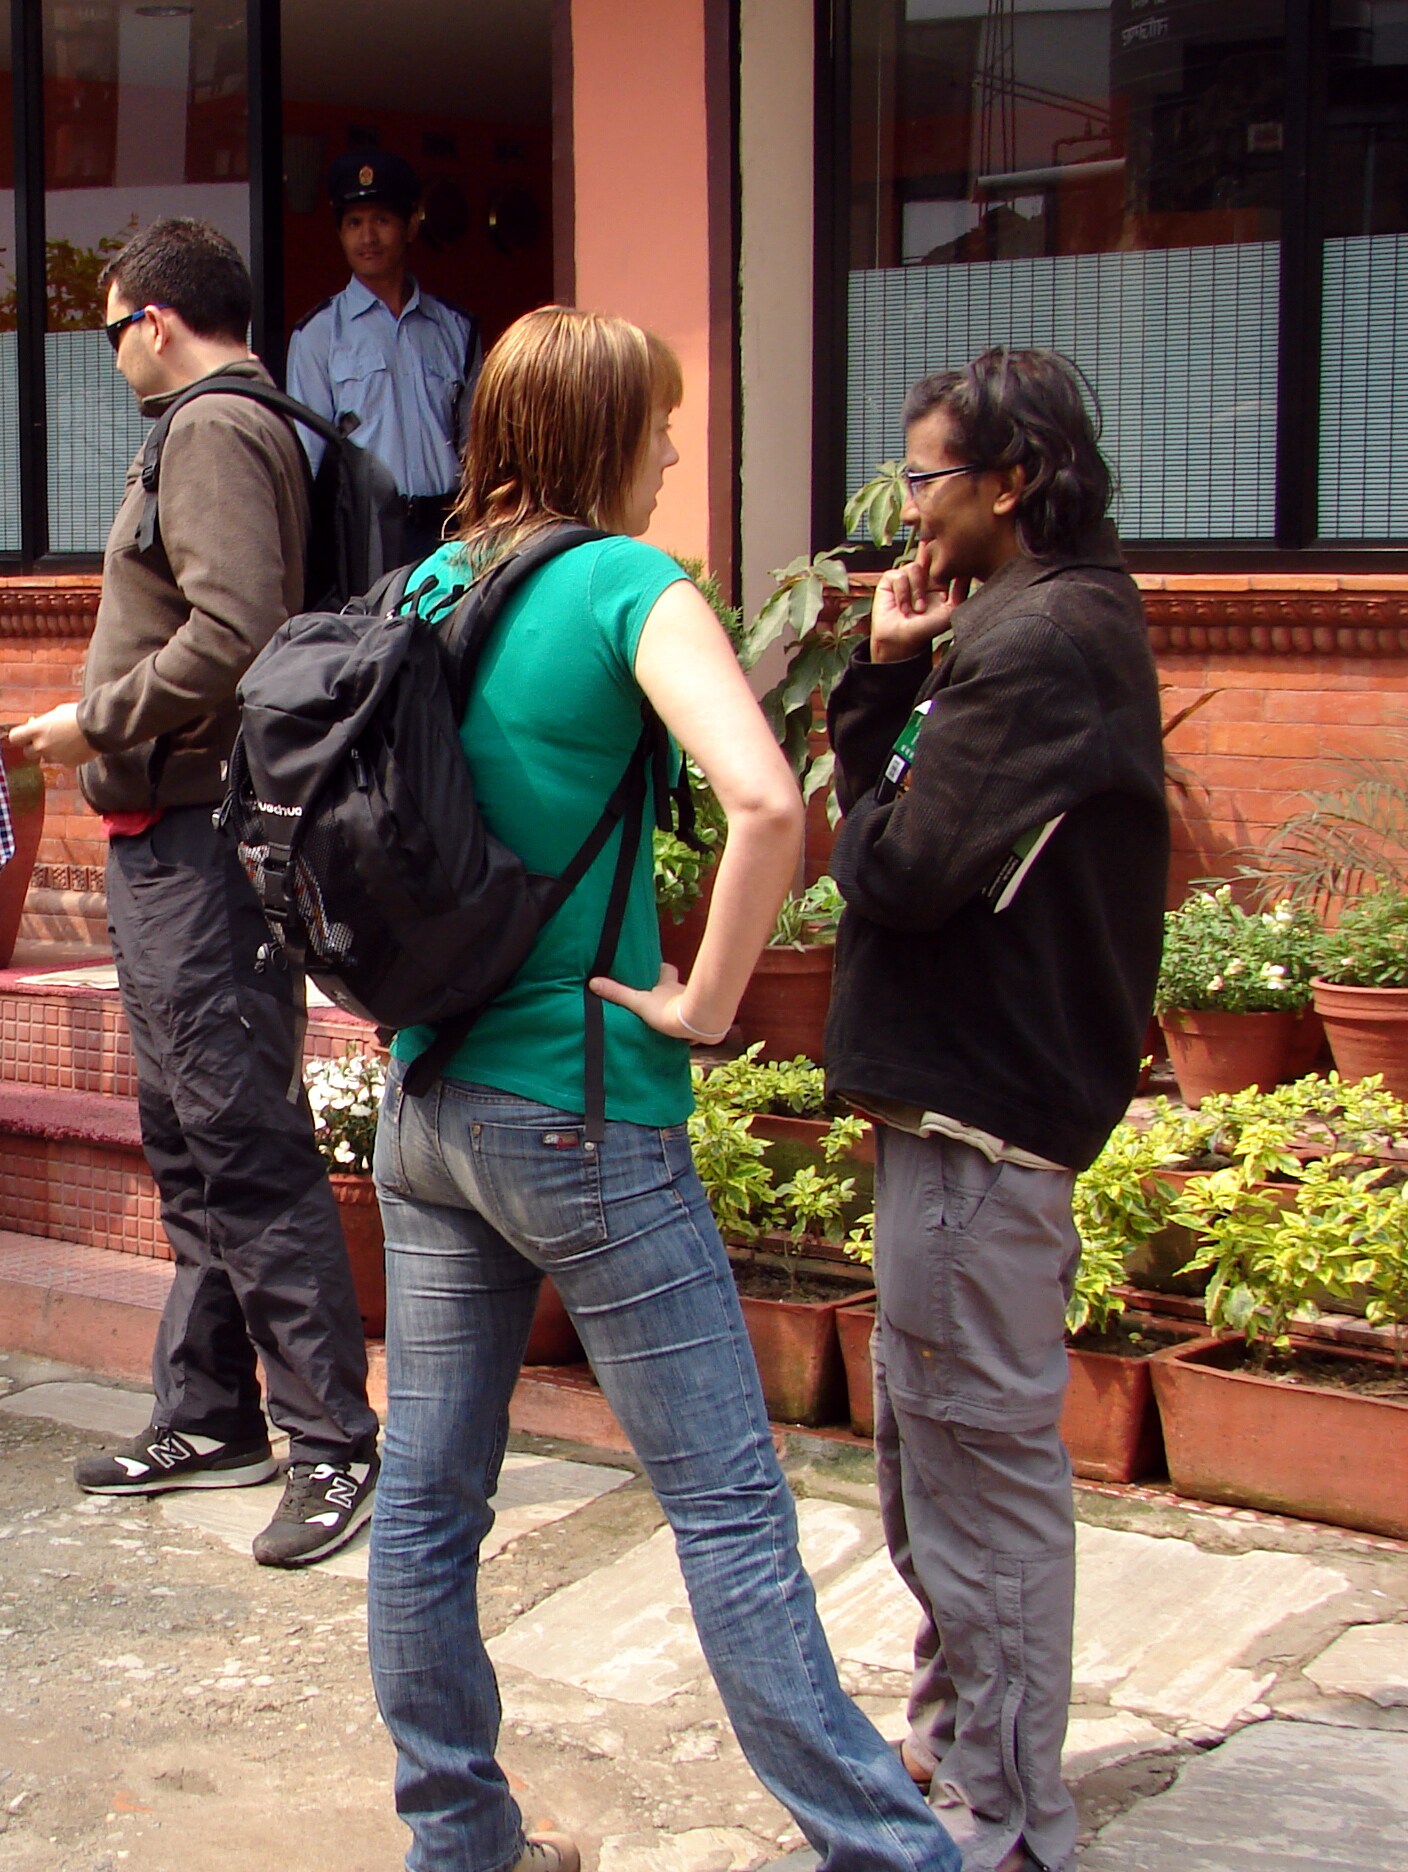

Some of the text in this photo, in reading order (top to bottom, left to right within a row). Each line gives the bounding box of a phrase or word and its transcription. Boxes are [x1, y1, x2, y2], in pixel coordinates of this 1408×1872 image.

[252, 801, 303, 817] uechua
[147, 1438, 191, 1469] N
[324, 1477, 358, 1509] N
